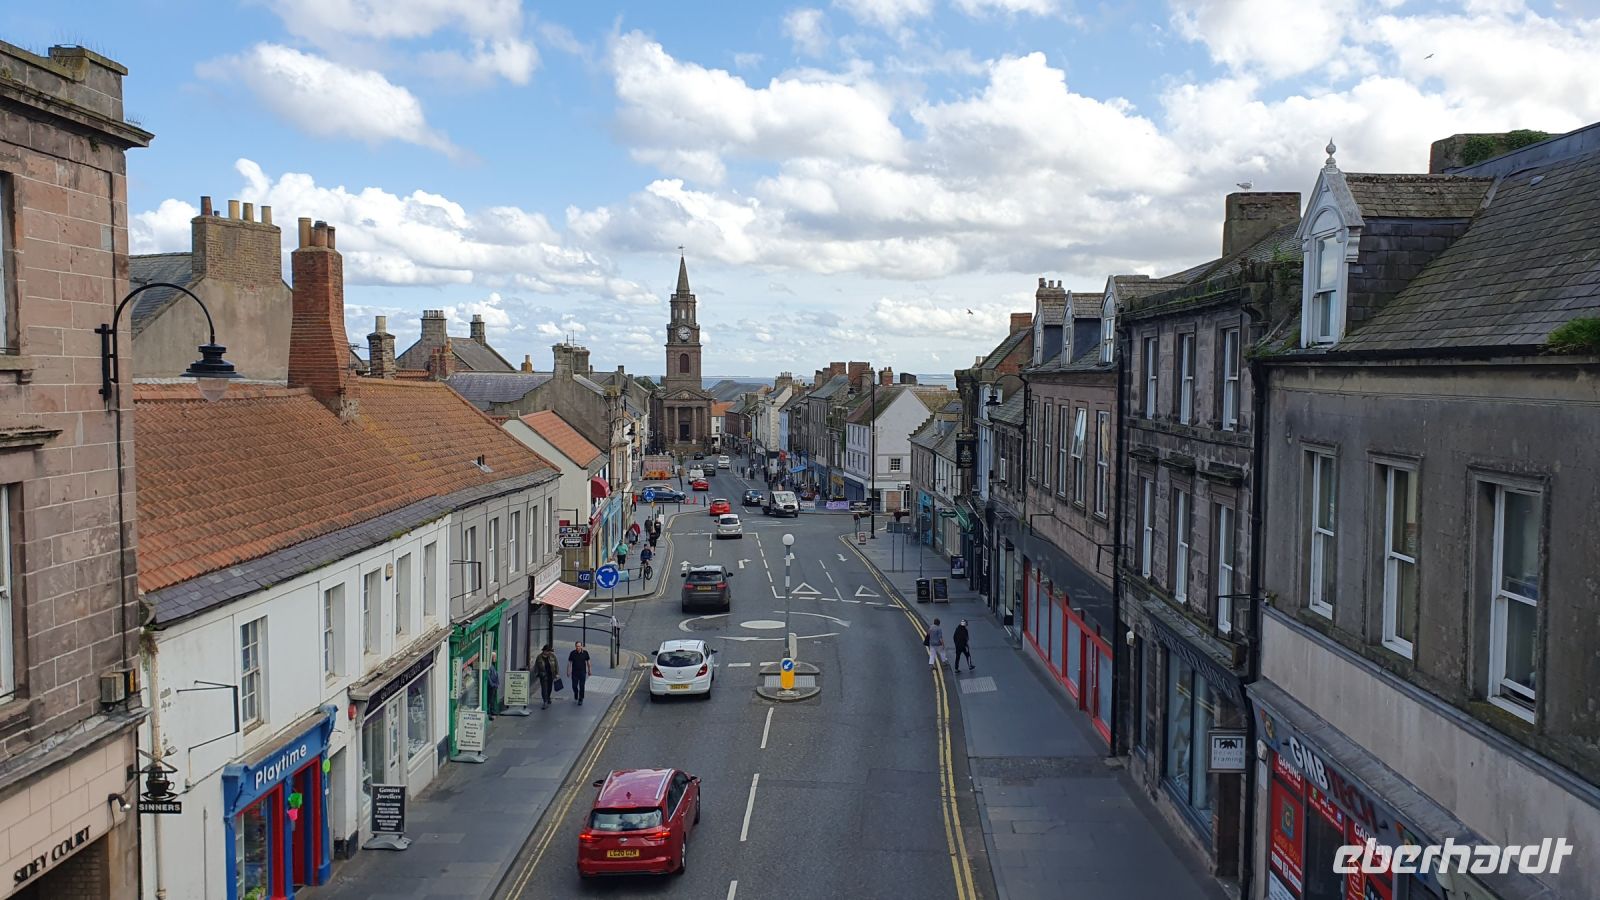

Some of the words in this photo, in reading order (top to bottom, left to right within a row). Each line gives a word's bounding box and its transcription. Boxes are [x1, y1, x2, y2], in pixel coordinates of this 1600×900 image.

[255, 744, 307, 790] playtime
[1289, 736, 1329, 791] GMB
[138, 803, 181, 811] SINNERS
[13, 851, 48, 888] SIDEY
[51, 825, 91, 864] COURT
